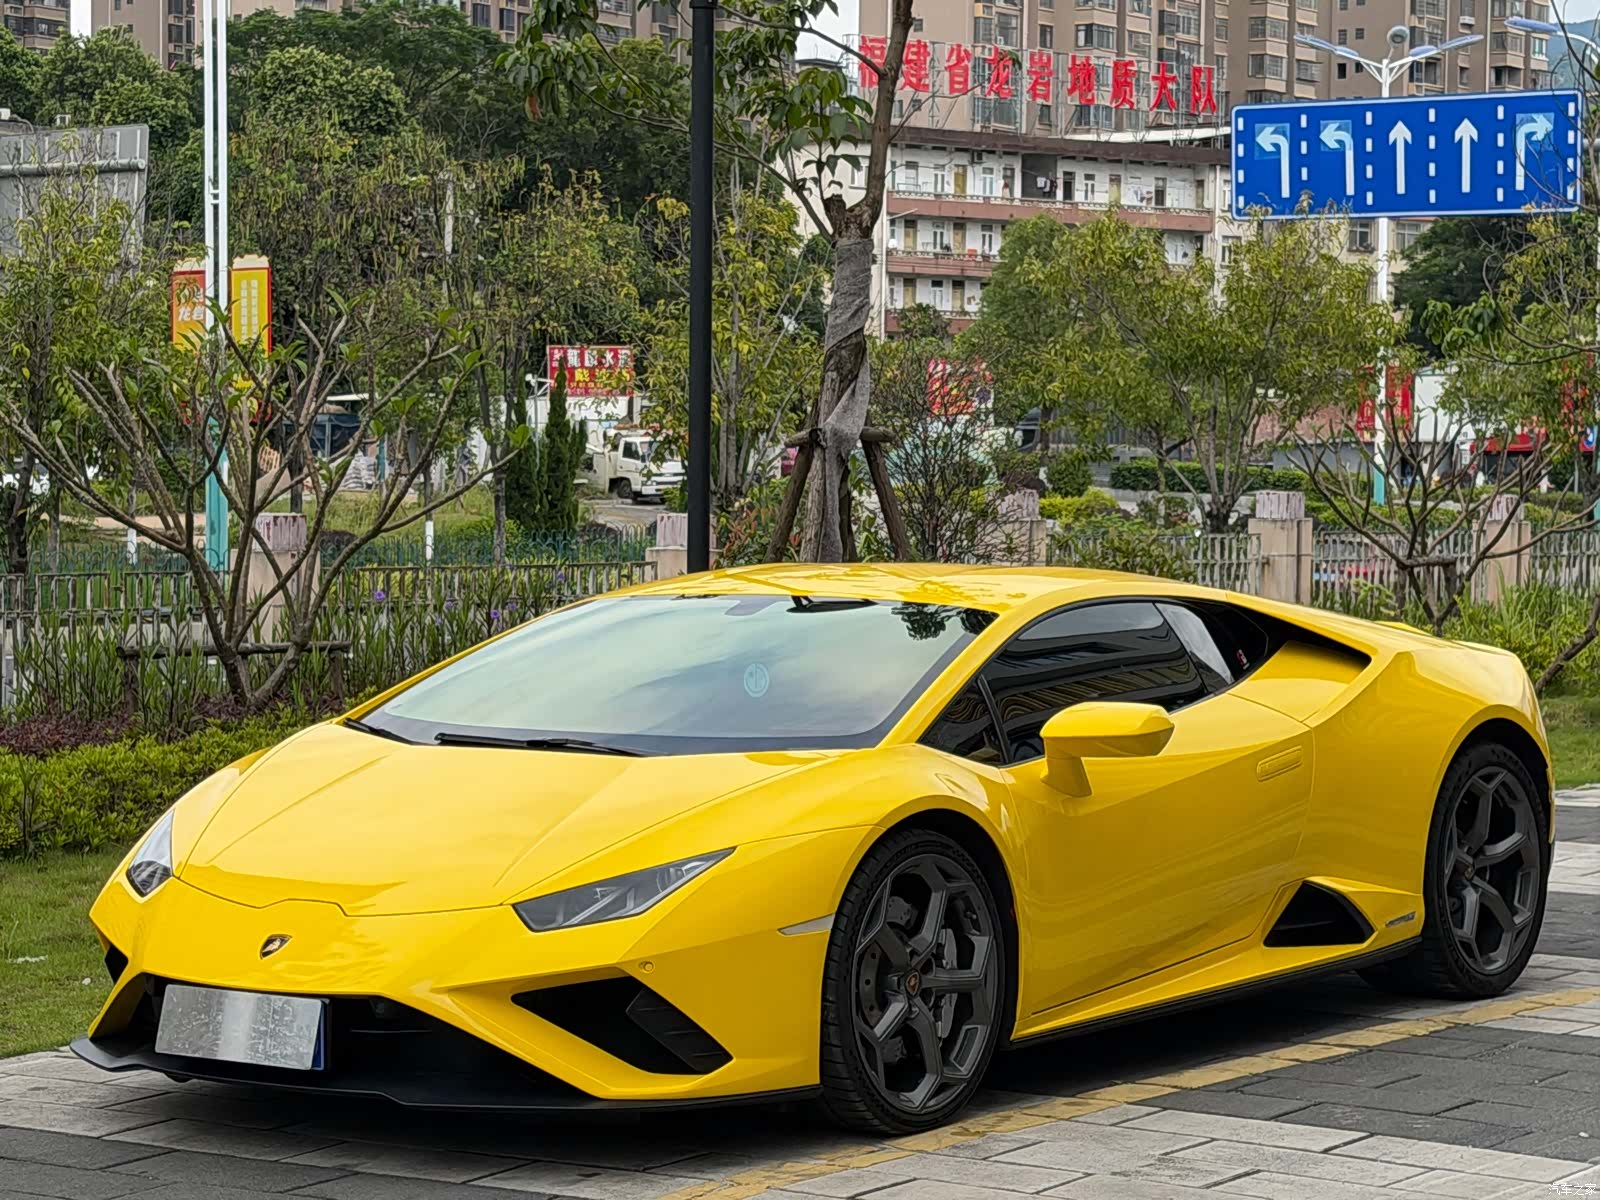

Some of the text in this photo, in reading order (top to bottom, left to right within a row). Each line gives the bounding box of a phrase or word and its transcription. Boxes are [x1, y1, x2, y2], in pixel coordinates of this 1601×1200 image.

[858, 35, 1216, 114] 福建省龙岩地质大队
